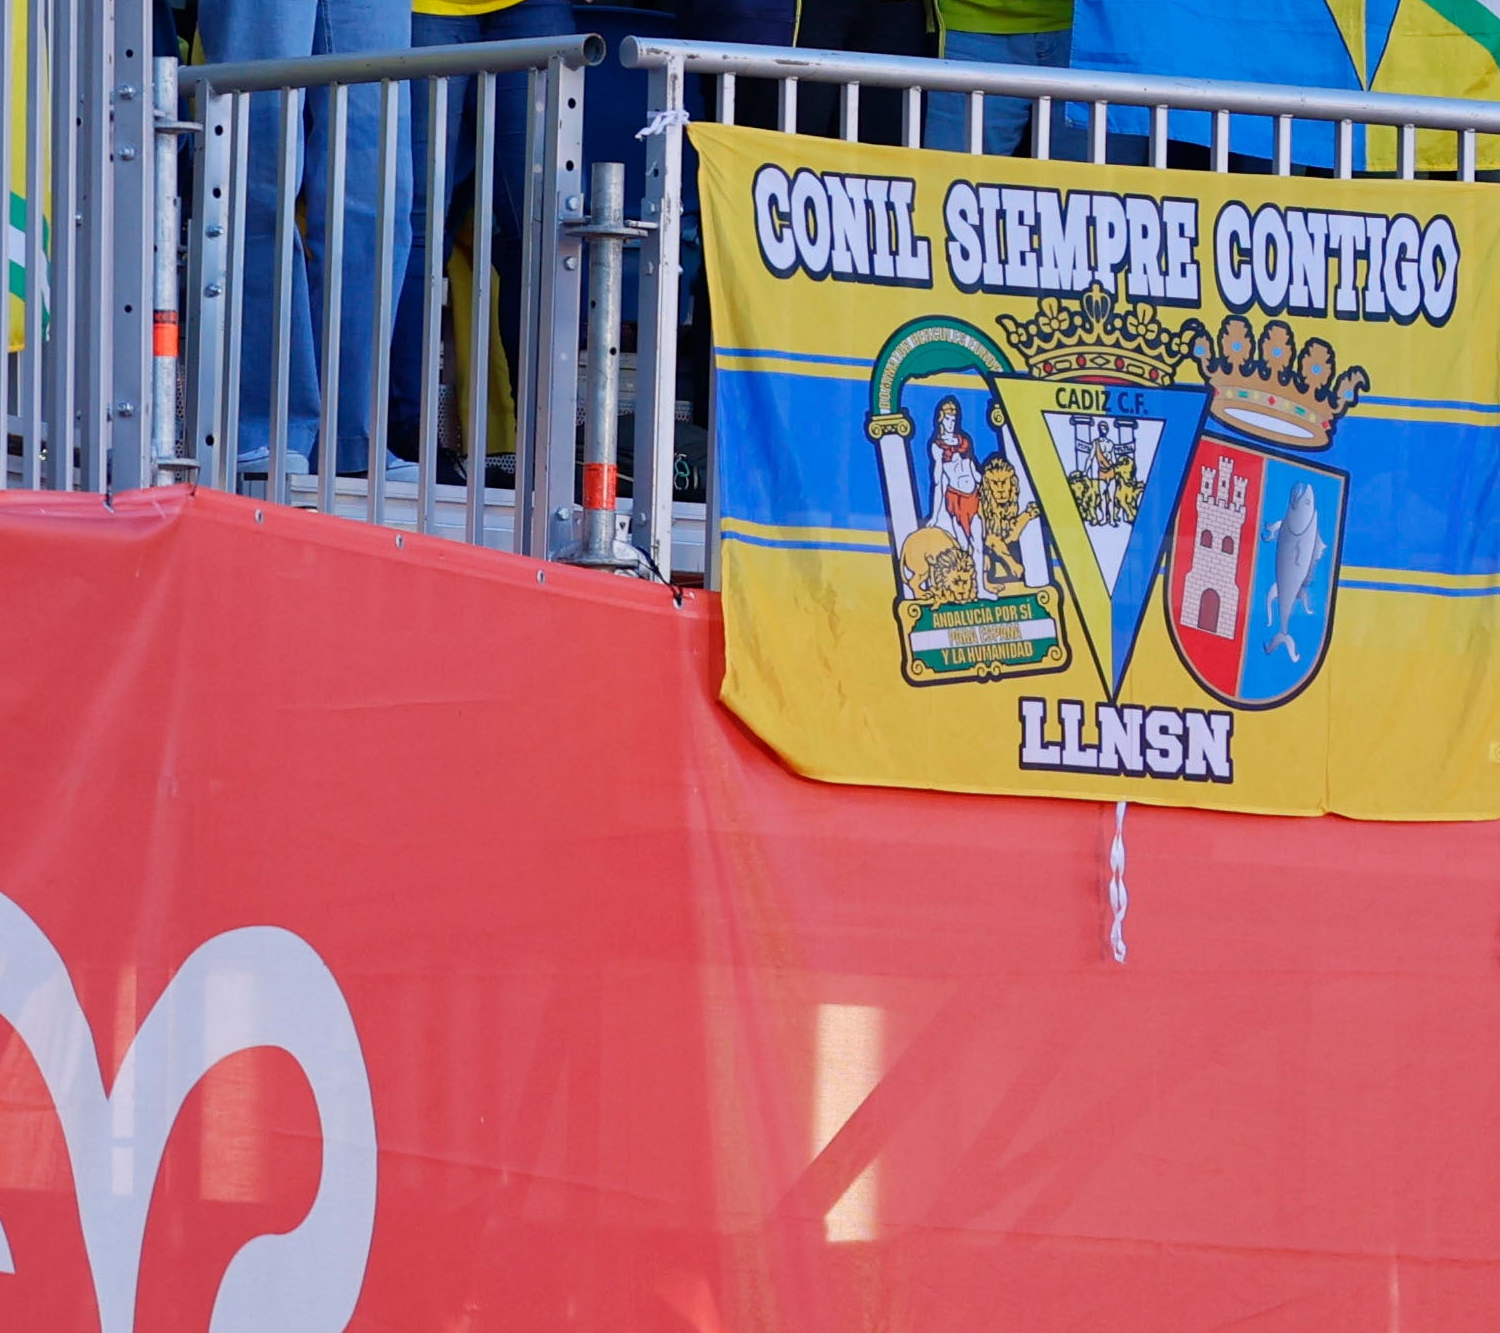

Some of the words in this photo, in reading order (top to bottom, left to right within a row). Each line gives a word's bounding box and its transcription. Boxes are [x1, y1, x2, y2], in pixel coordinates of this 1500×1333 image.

[752, 162, 934, 289] CONIL
[942, 179, 1202, 309] SIEMPRE
[1214, 203, 1460, 326] CONTIGO
[1055, 386, 1112, 412] CADIZ
[1117, 392, 1148, 415] C.F.
[995, 606, 1018, 621] POR
[941, 647, 950, 664] Y
[951, 647, 967, 664] LA
[1018, 697, 1235, 784] LLNSN
